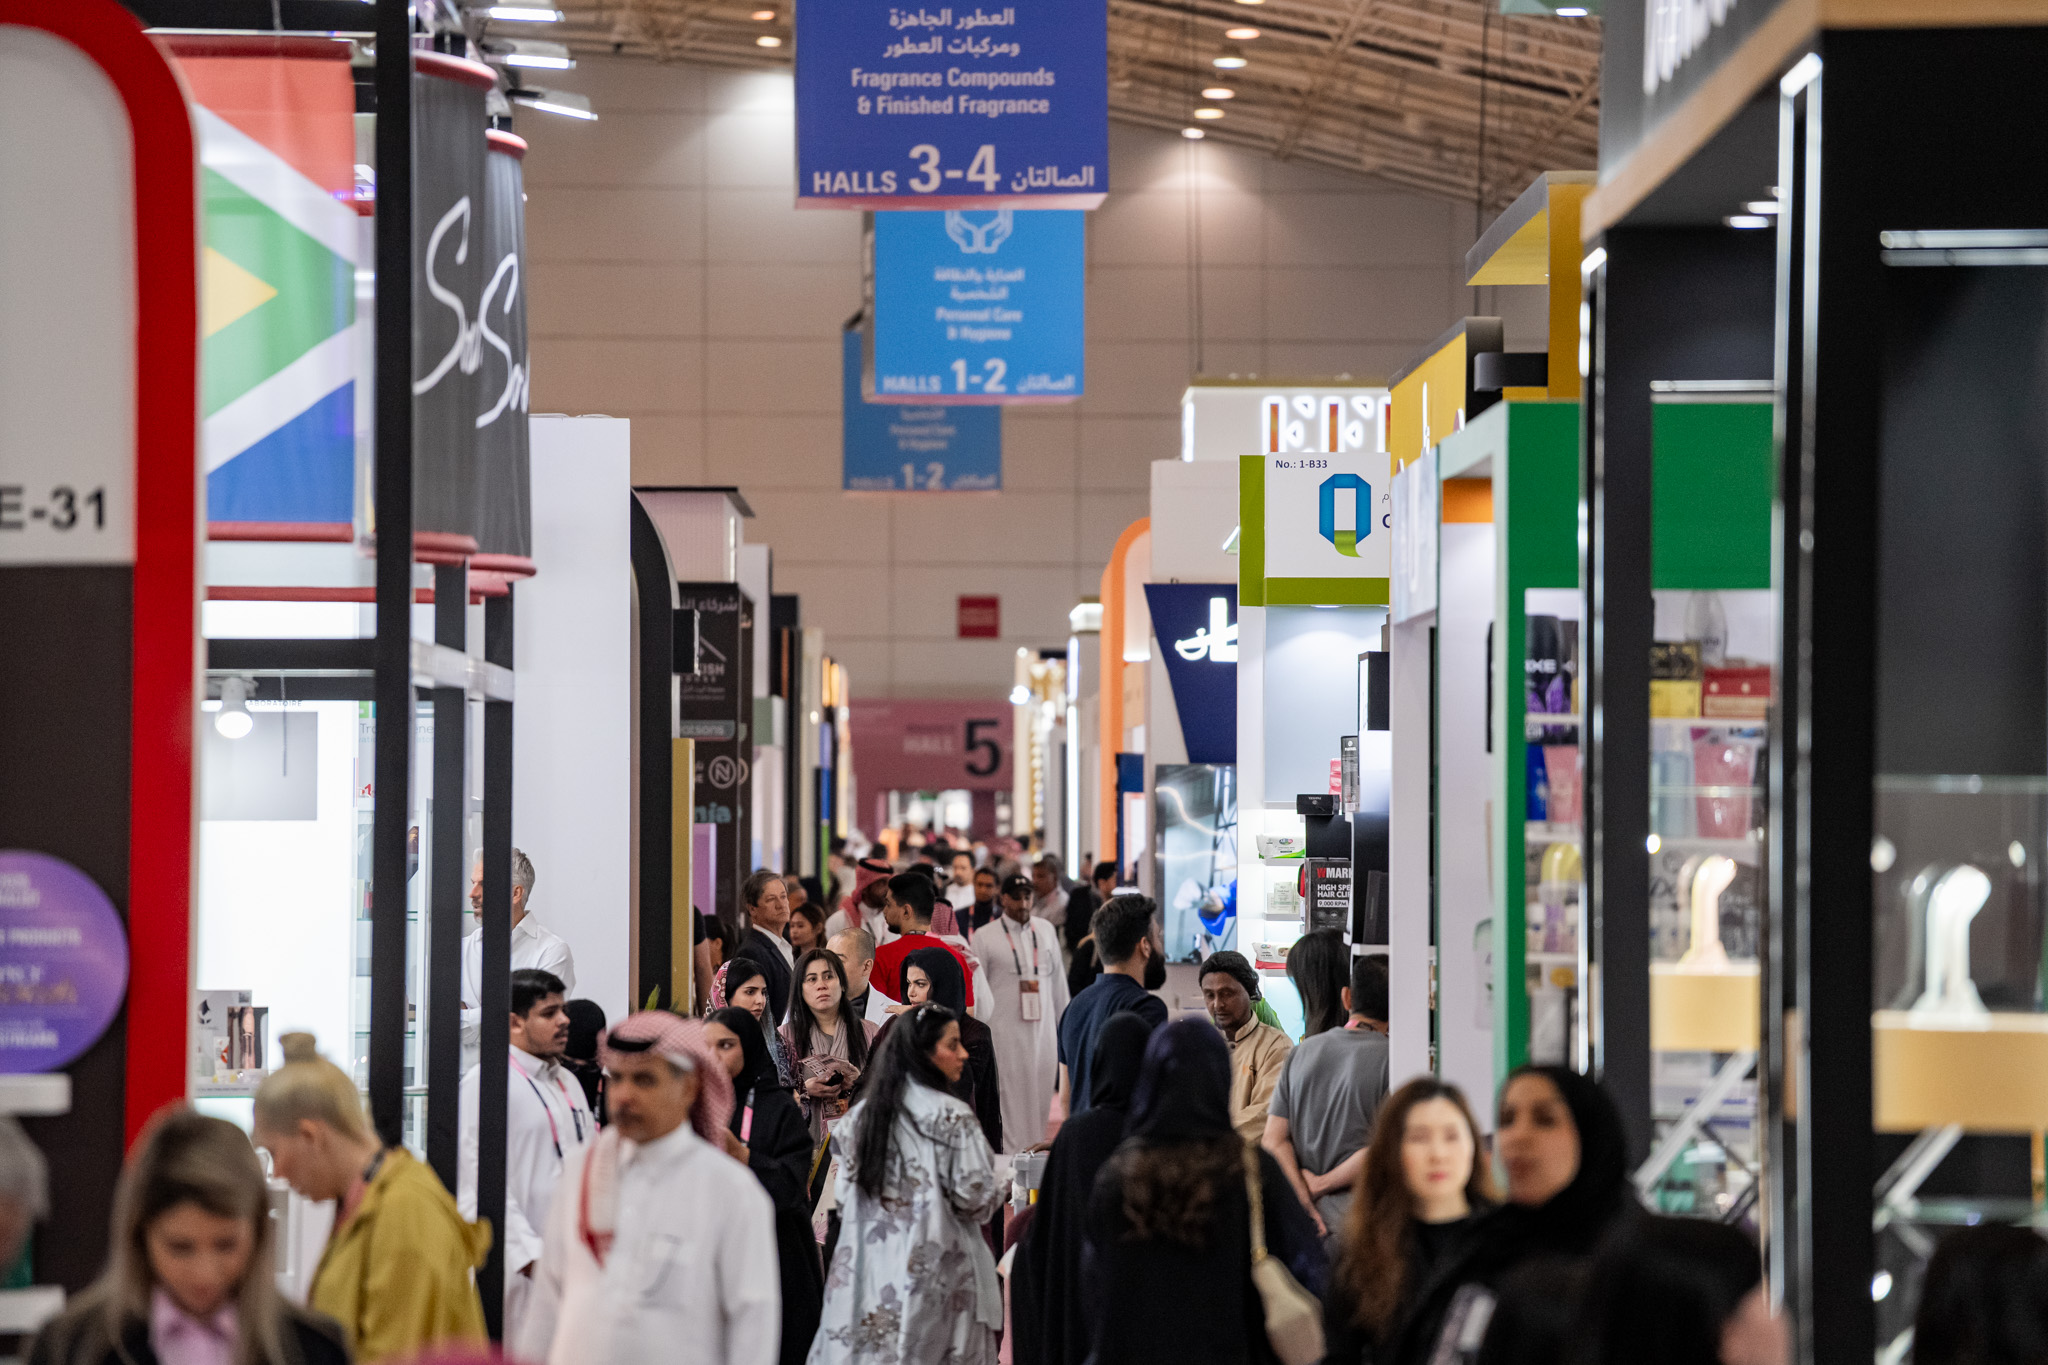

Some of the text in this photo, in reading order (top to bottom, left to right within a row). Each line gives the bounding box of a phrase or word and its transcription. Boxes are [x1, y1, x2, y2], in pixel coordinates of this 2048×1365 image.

[889, 8, 1015, 31] العطور الجاهزة
[883, 36, 1021, 58] ومركبات العطور
[851, 67, 1055, 91] Fragrance Compounds
[857, 95, 1050, 118] & Finished Fragrance
[813, 144, 1095, 193] HALLS 3-4 الصالتان
[883, 375, 942, 393] HALLS
[950, 358, 1007, 393] 1-2
[902, 462, 946, 490] 1-2
[1276, 459, 1328, 469] No.: 1-B33
[964, 717, 1001, 778] 5
